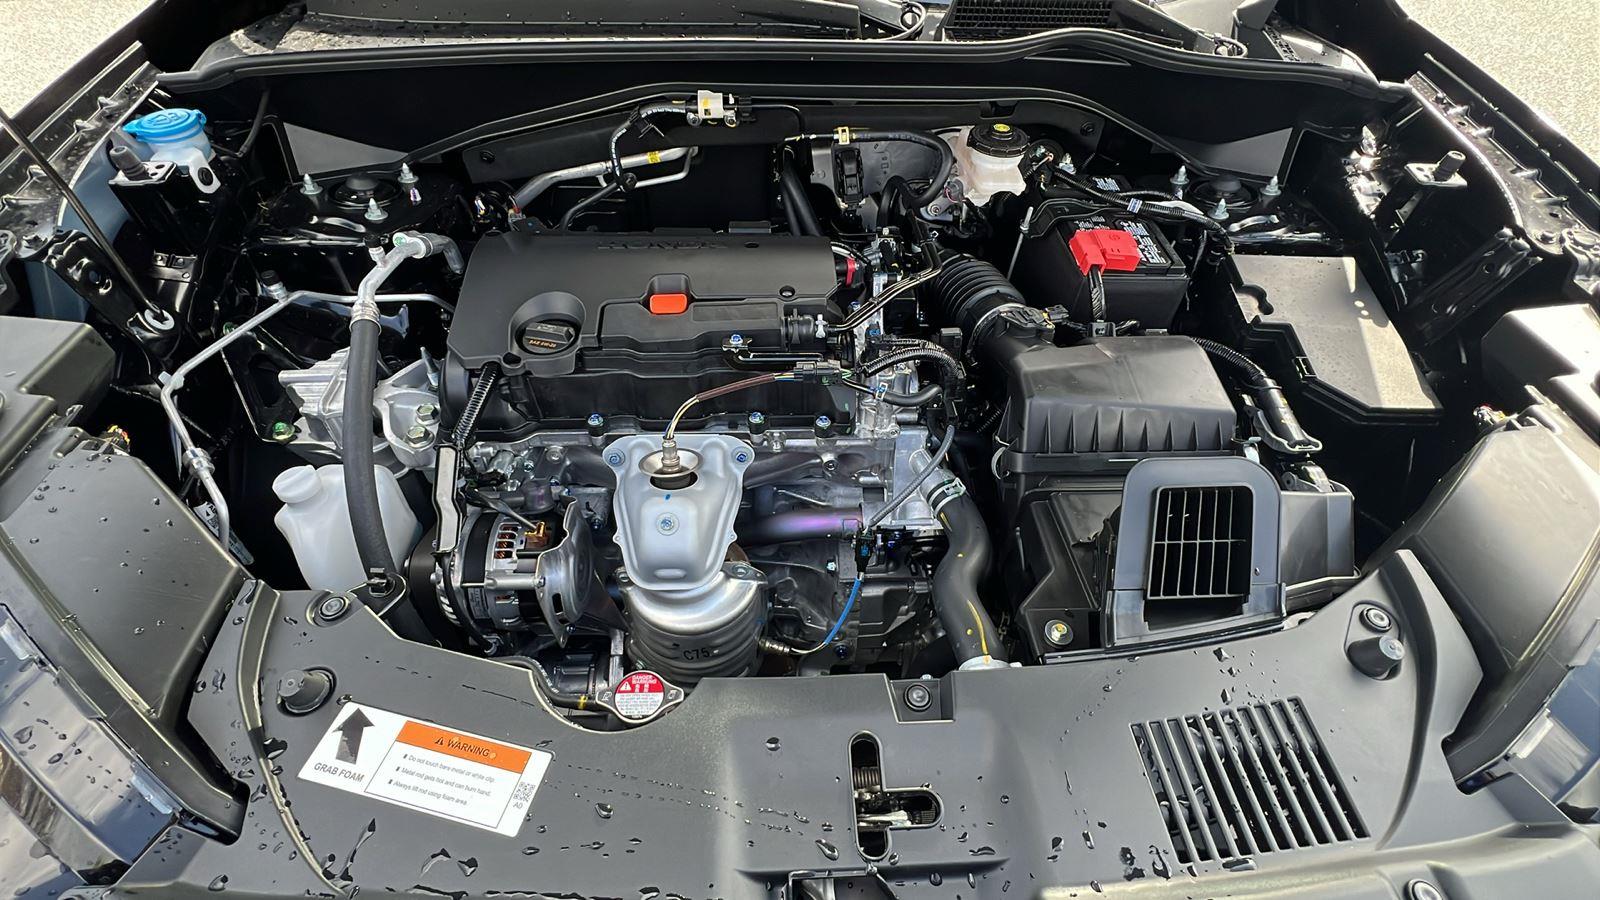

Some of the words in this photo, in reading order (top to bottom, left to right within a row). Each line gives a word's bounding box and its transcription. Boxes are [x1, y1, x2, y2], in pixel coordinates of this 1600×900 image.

[447, 739, 490, 757] WARNING
[408, 754, 416, 762] Do
[425, 759, 439, 768] touch
[314, 762, 338, 776] GRAB
[338, 769, 365, 783] FOAM
[401, 767, 415, 776] Metal
